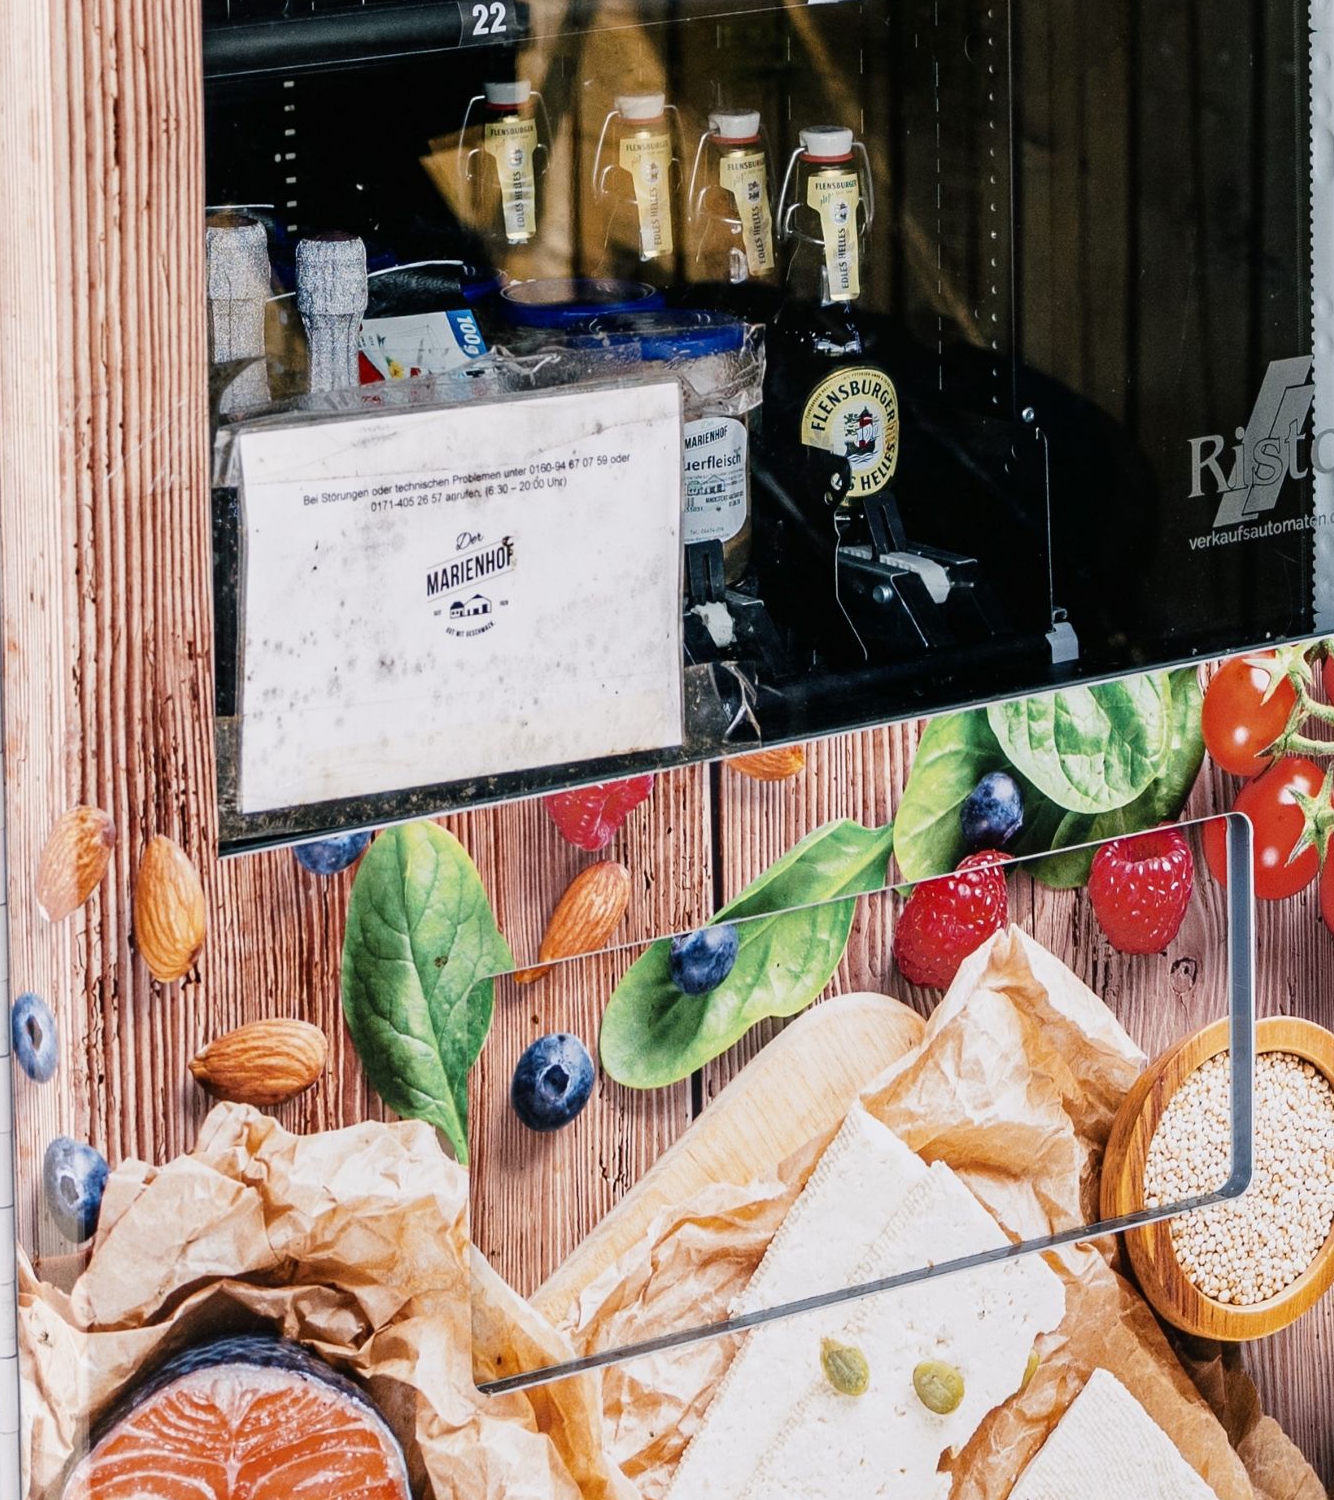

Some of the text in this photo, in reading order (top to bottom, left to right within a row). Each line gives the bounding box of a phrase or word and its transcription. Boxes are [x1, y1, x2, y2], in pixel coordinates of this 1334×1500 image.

[472, 2, 507, 35] 22
[815, 179, 857, 191] FLENSBURGER
[837, 228, 849, 289] EDLES HELLES
[811, 379, 896, 431] FLENSBURGER
[684, 425, 728, 450] MARIENHOF
[303, 494, 318, 506] Bei
[321, 488, 369, 502] Störungen
[371, 486, 392, 497] oder
[395, 478, 450, 493] technischen
[452, 470, 501, 484] Problemen
[504, 467, 527, 478] unter
[582, 457, 594, 468] 07
[597, 455, 608, 466] 59
[610, 454, 630, 464] oder
[860, 442, 896, 491] HELLES
[456, 531, 484, 551] Der
[427, 545, 514, 597] MARIENHOF
